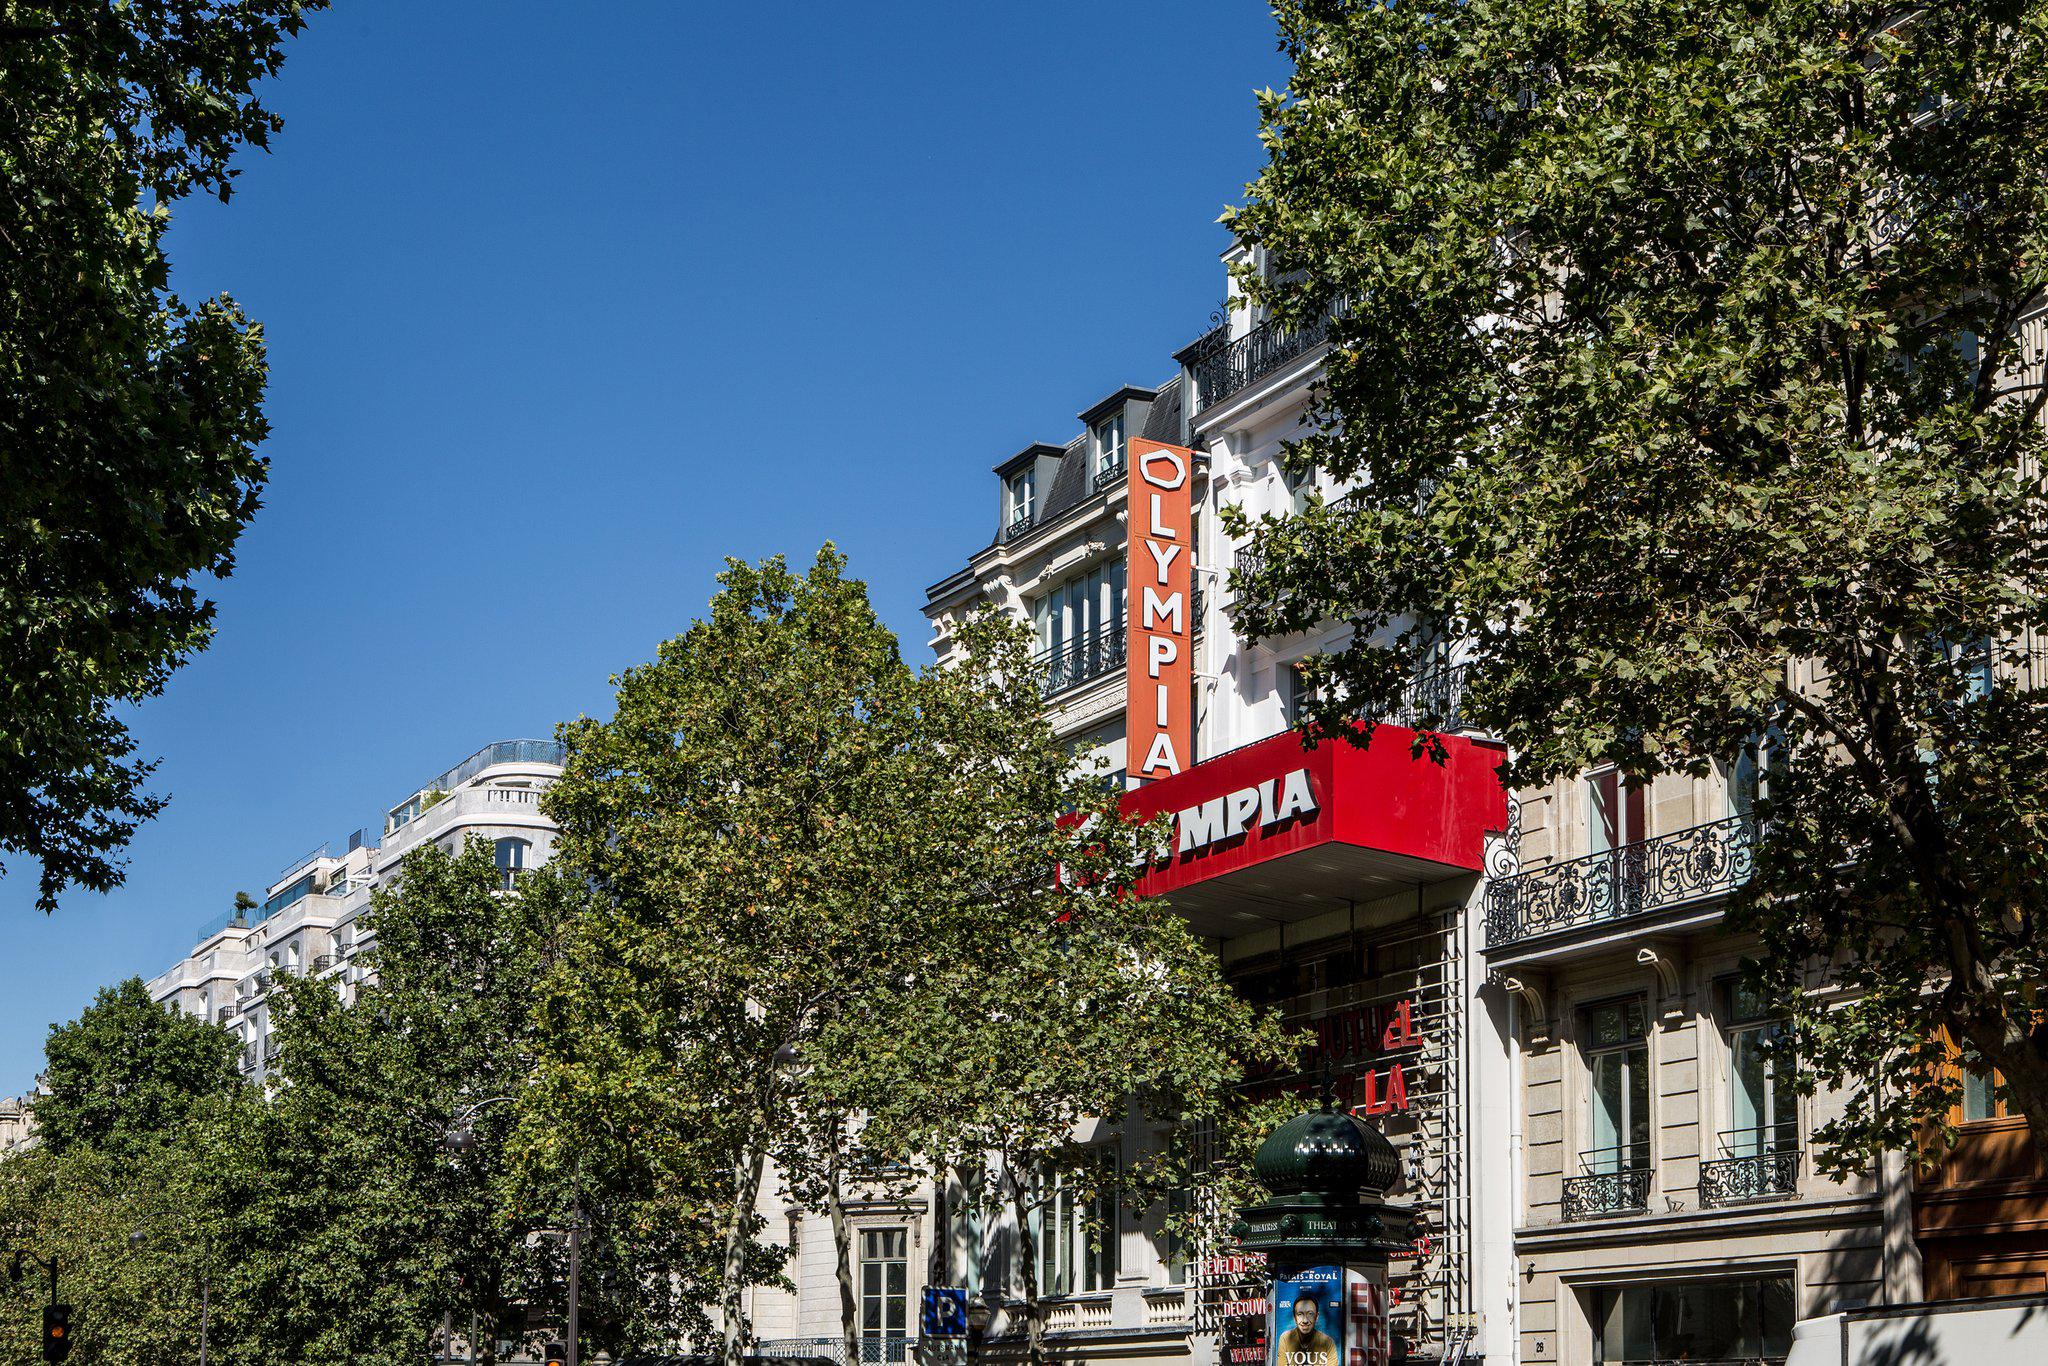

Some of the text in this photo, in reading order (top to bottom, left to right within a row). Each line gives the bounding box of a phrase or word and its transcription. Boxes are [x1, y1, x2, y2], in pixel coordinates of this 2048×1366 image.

[1139, 448, 1186, 776] OLYMPIA
[1060, 769, 1318, 900] LYMPIA
[1364, 1063, 1406, 1116] LA
[1307, 1220, 1358, 1231] THEATS
[1280, 1272, 1337, 1280] PALAIS-ROYAL
[937, 1296, 957, 1327] P
[1285, 1351, 1328, 1365] VOUS
